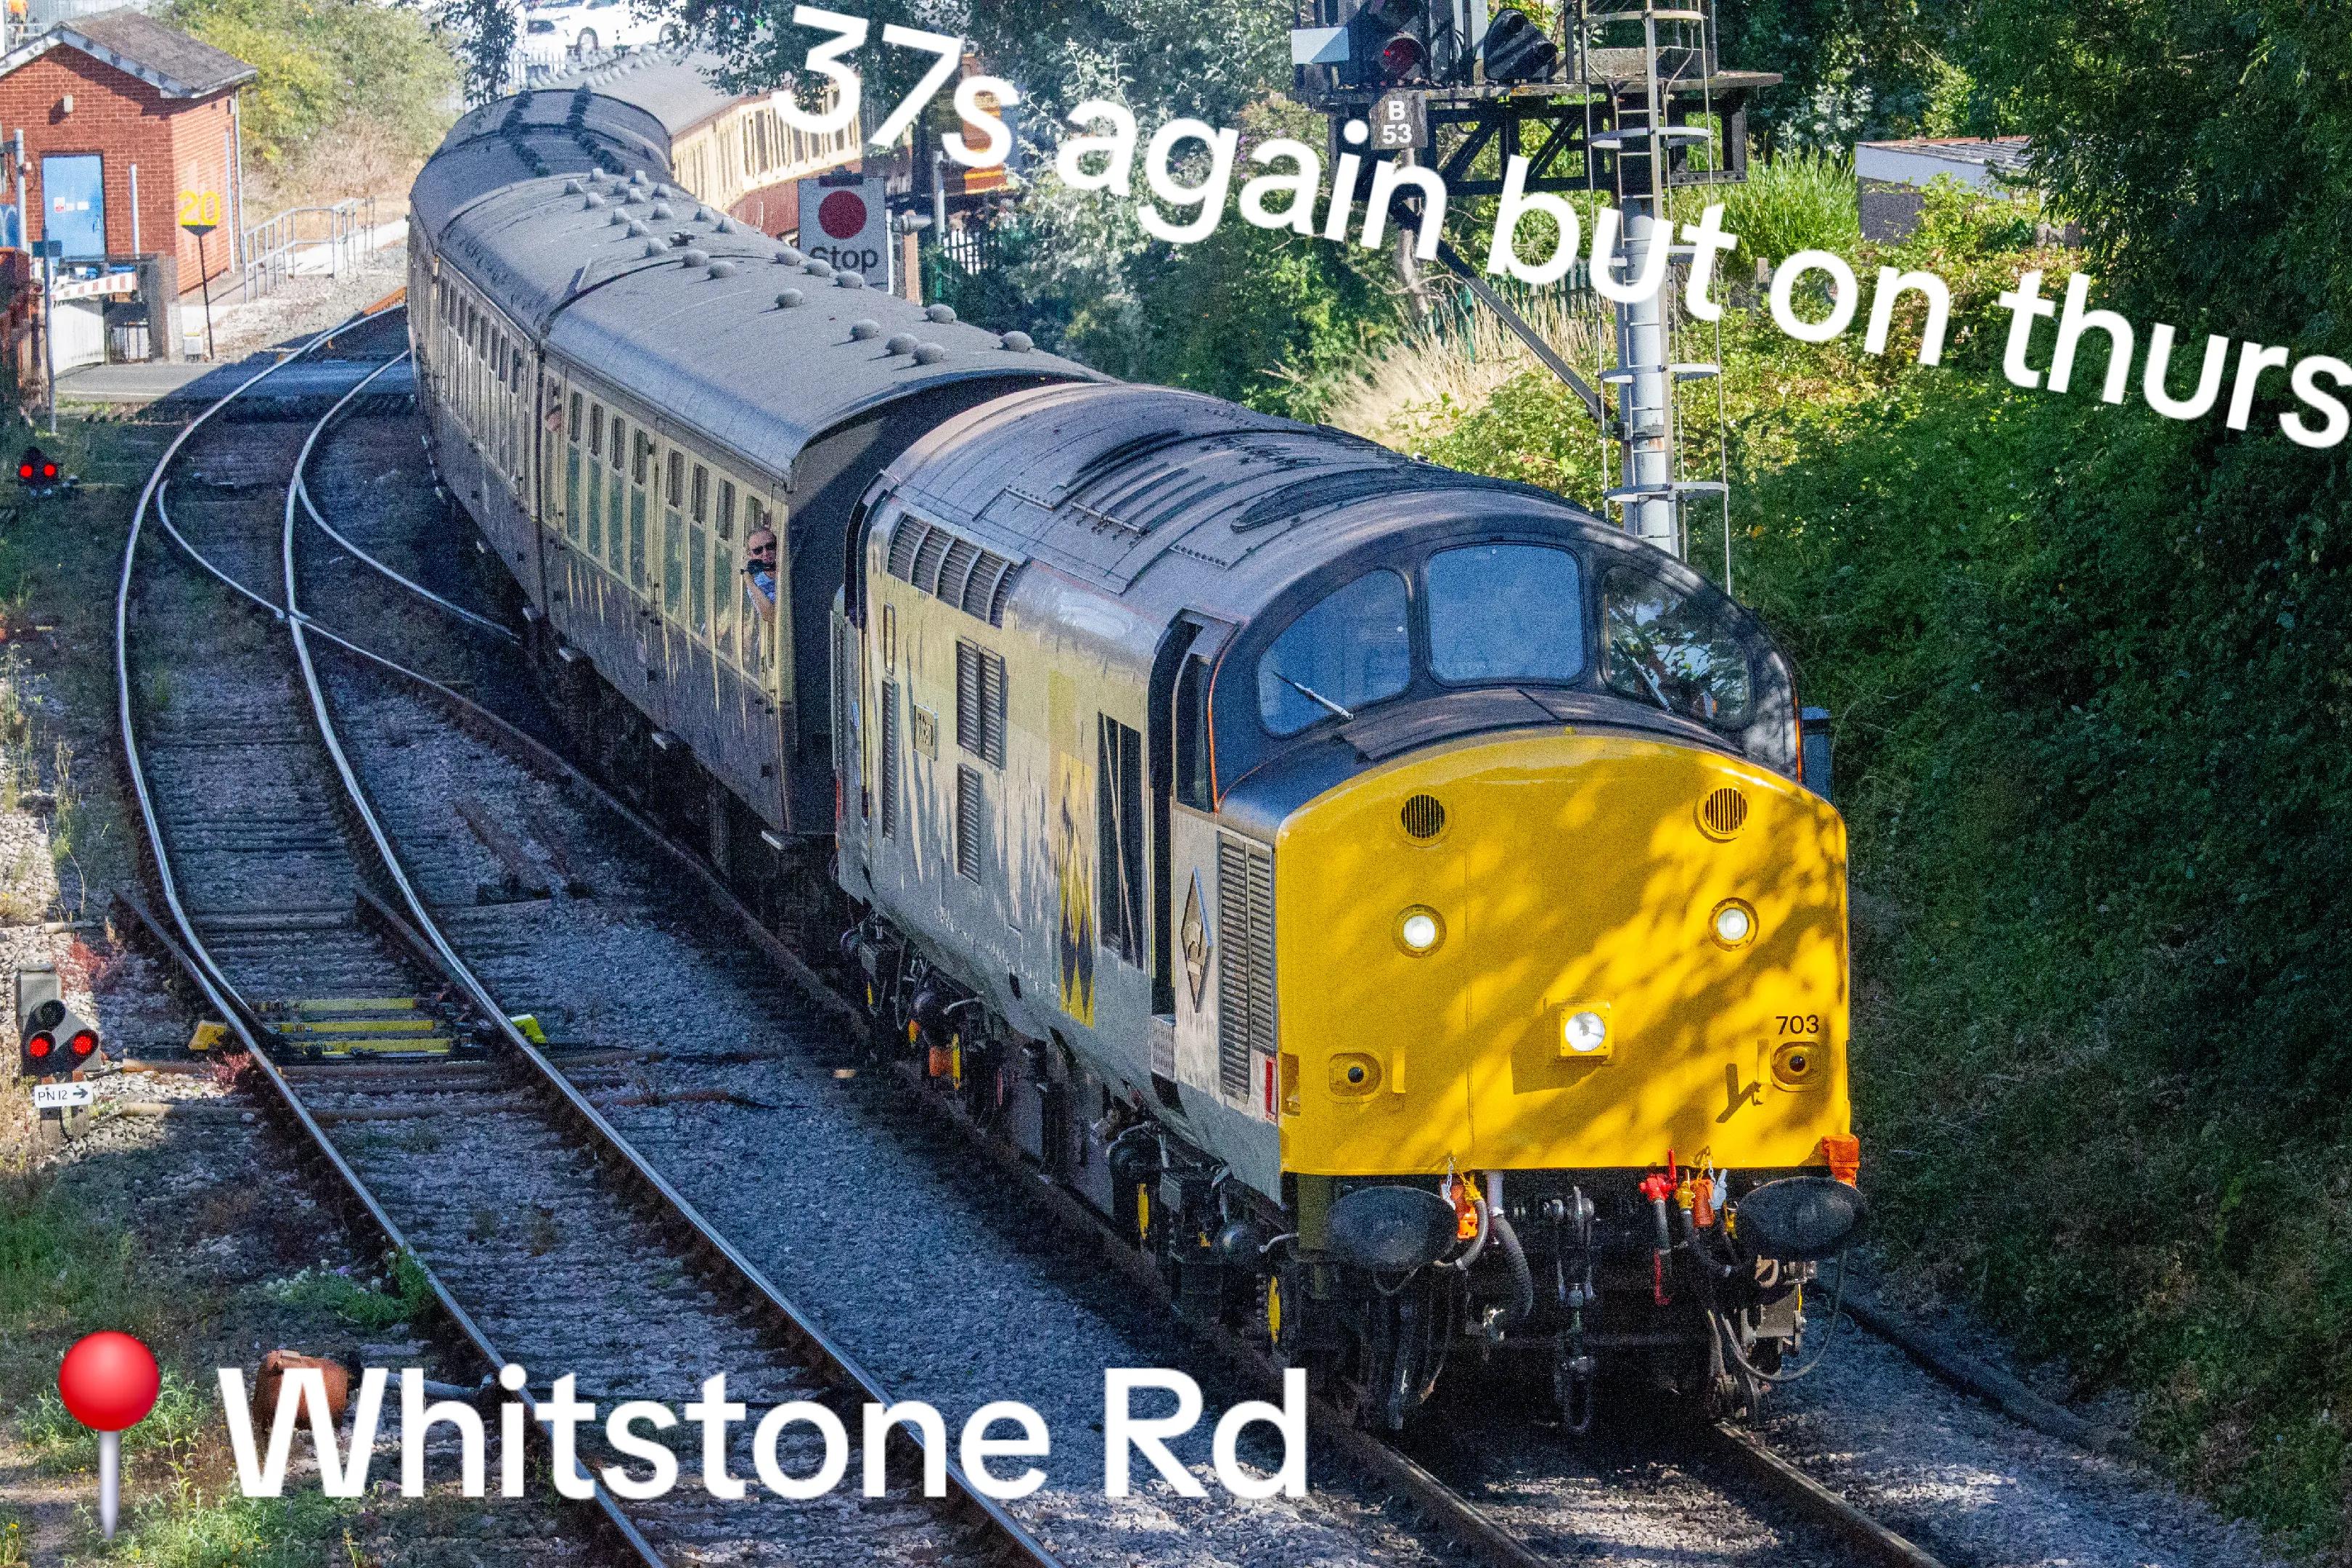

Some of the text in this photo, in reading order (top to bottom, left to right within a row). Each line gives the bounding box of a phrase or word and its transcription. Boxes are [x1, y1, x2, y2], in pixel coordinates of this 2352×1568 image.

[1389, 101, 1405, 121] B
[1383, 123, 1412, 144] 53
[179, 190, 221, 226] 20
[1776, 1015, 1819, 1035] 703
